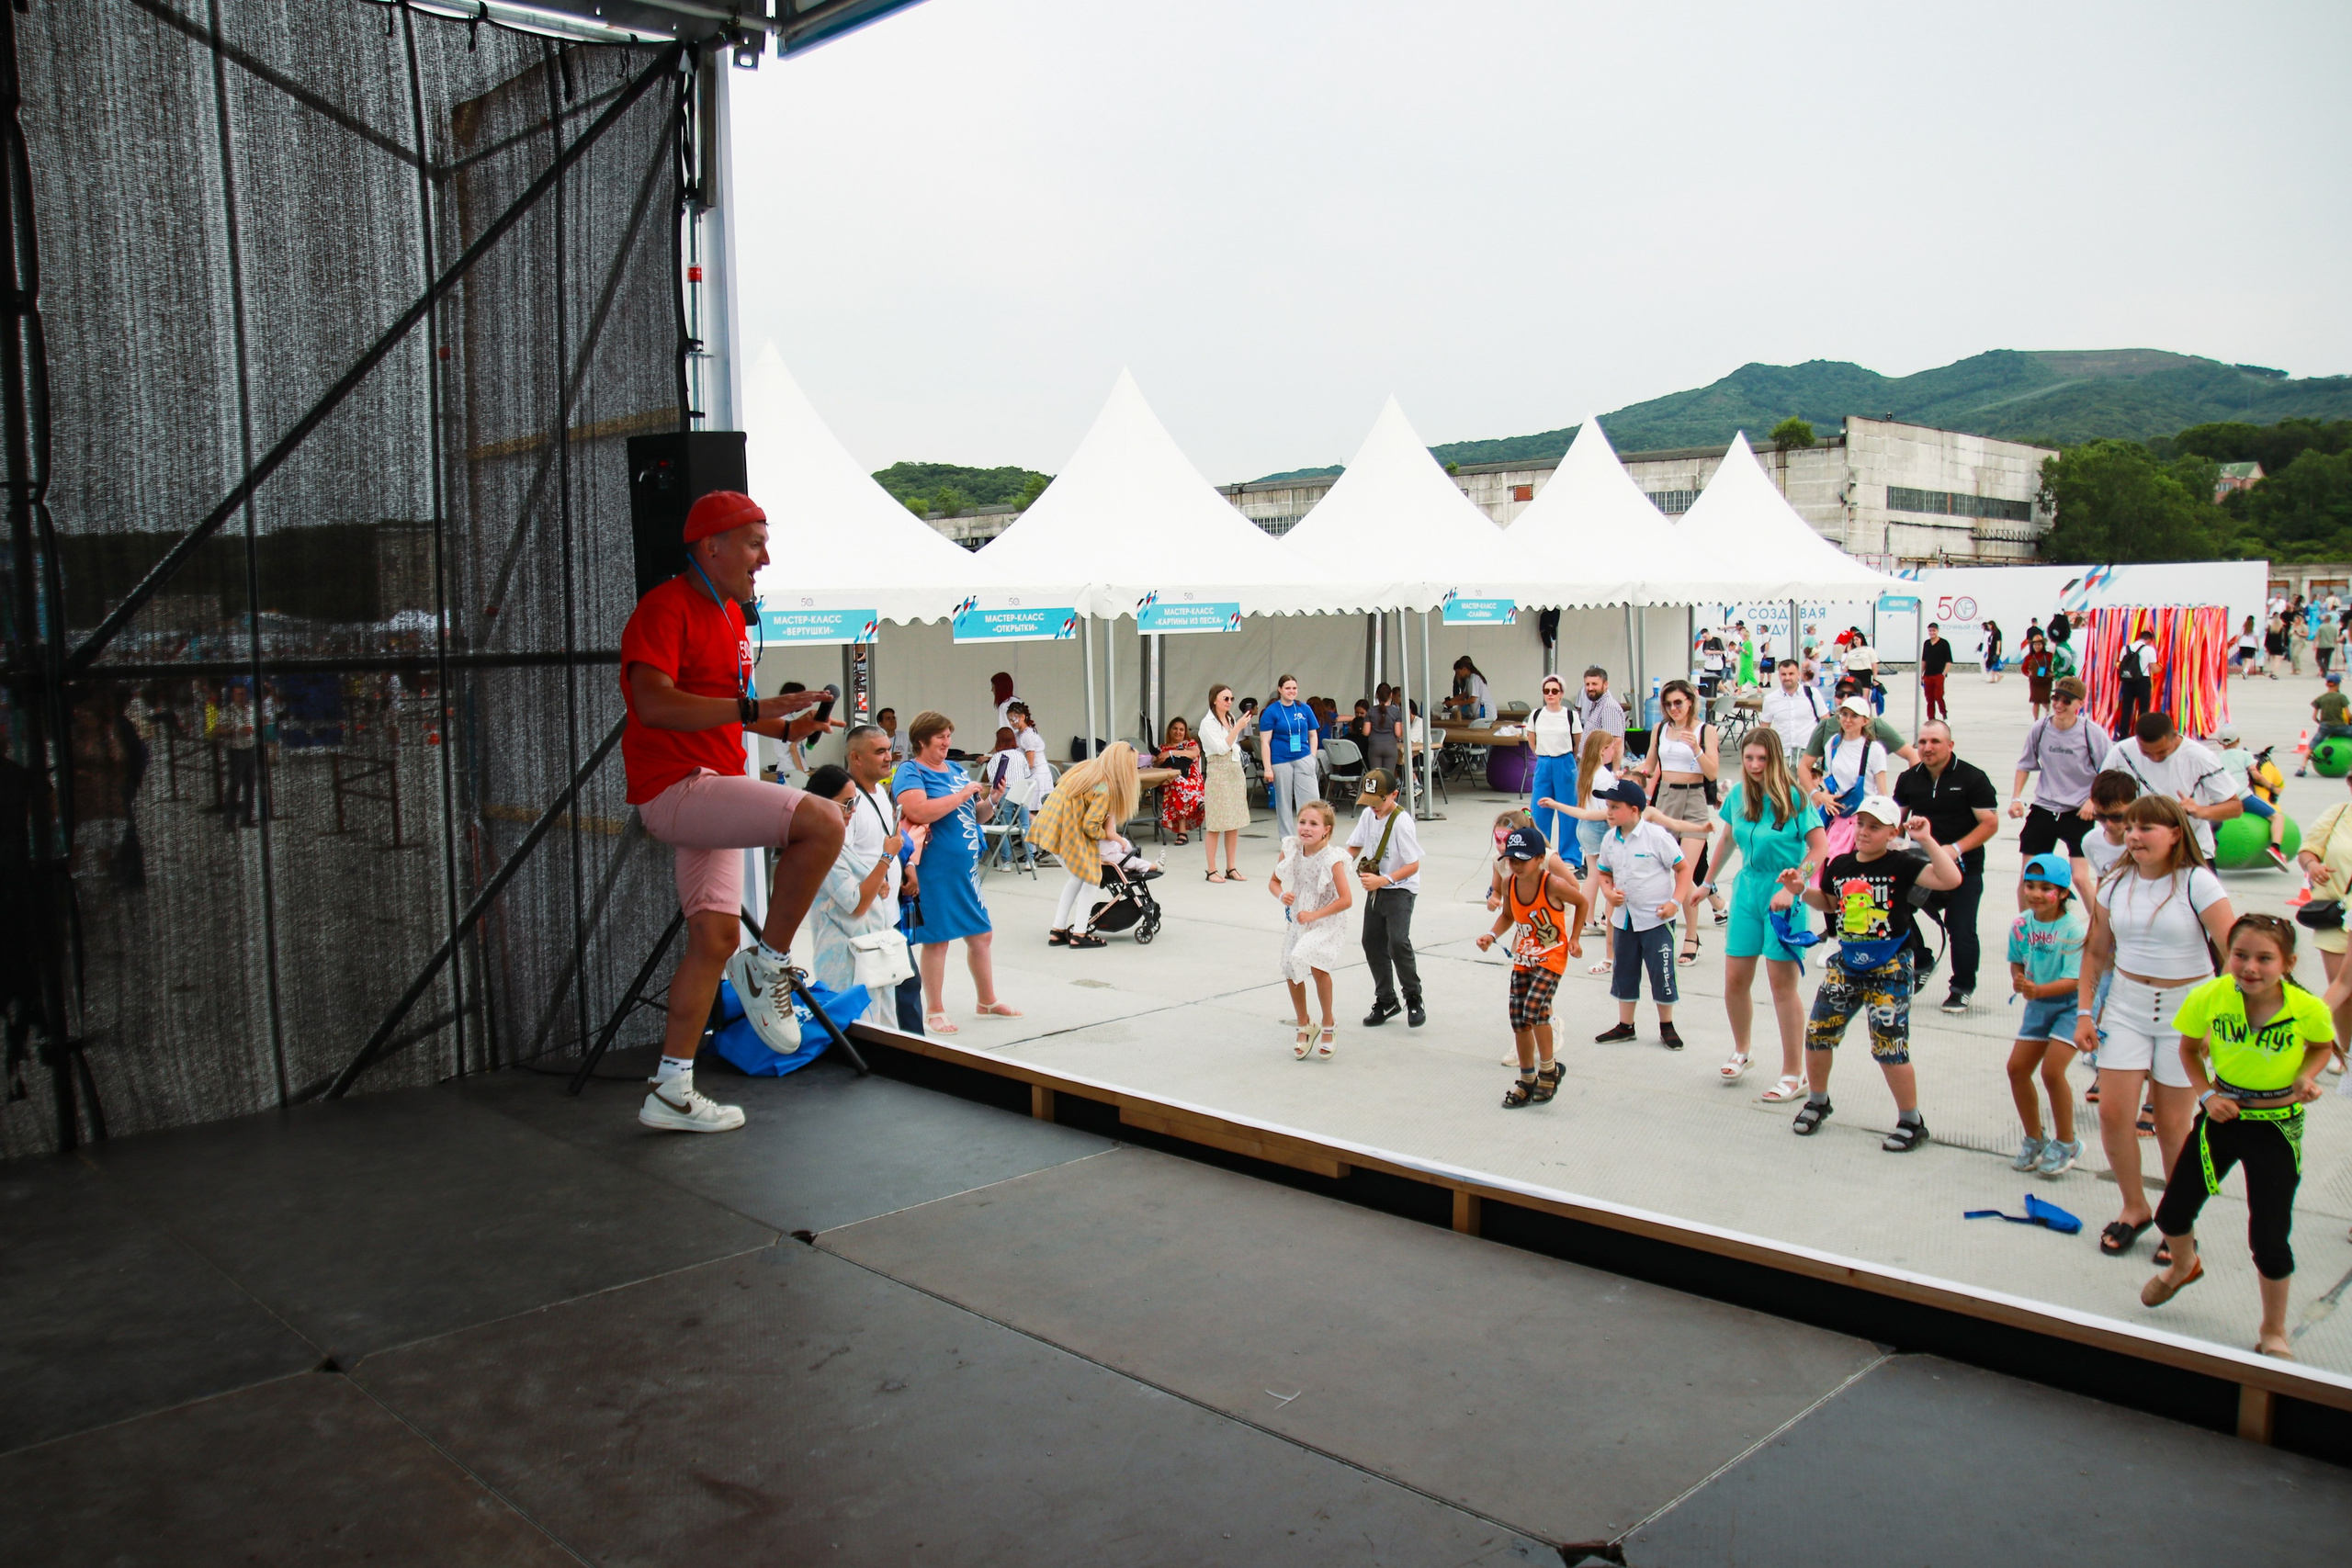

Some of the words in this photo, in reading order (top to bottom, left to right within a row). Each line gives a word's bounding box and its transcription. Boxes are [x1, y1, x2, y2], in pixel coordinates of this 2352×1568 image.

[1164, 607, 1215, 615] МАСТЕР-КЛАСС
[1936, 596, 1977, 621] 50
[985, 613, 1045, 623] МАСТЕР-КЛАСС
[1747, 607, 1826, 621] СОЗДВАЯ
[773, 615, 842, 625] МАСТЕР-КЛАСС
[1199, 616, 1224, 625] ПЕСКА»
[782, 626, 834, 636] «ВЕРТУШКИ»
[992, 624, 1038, 633] «ОТКРЫТКИ»
[2215, 1013, 2242, 1022] YOU
